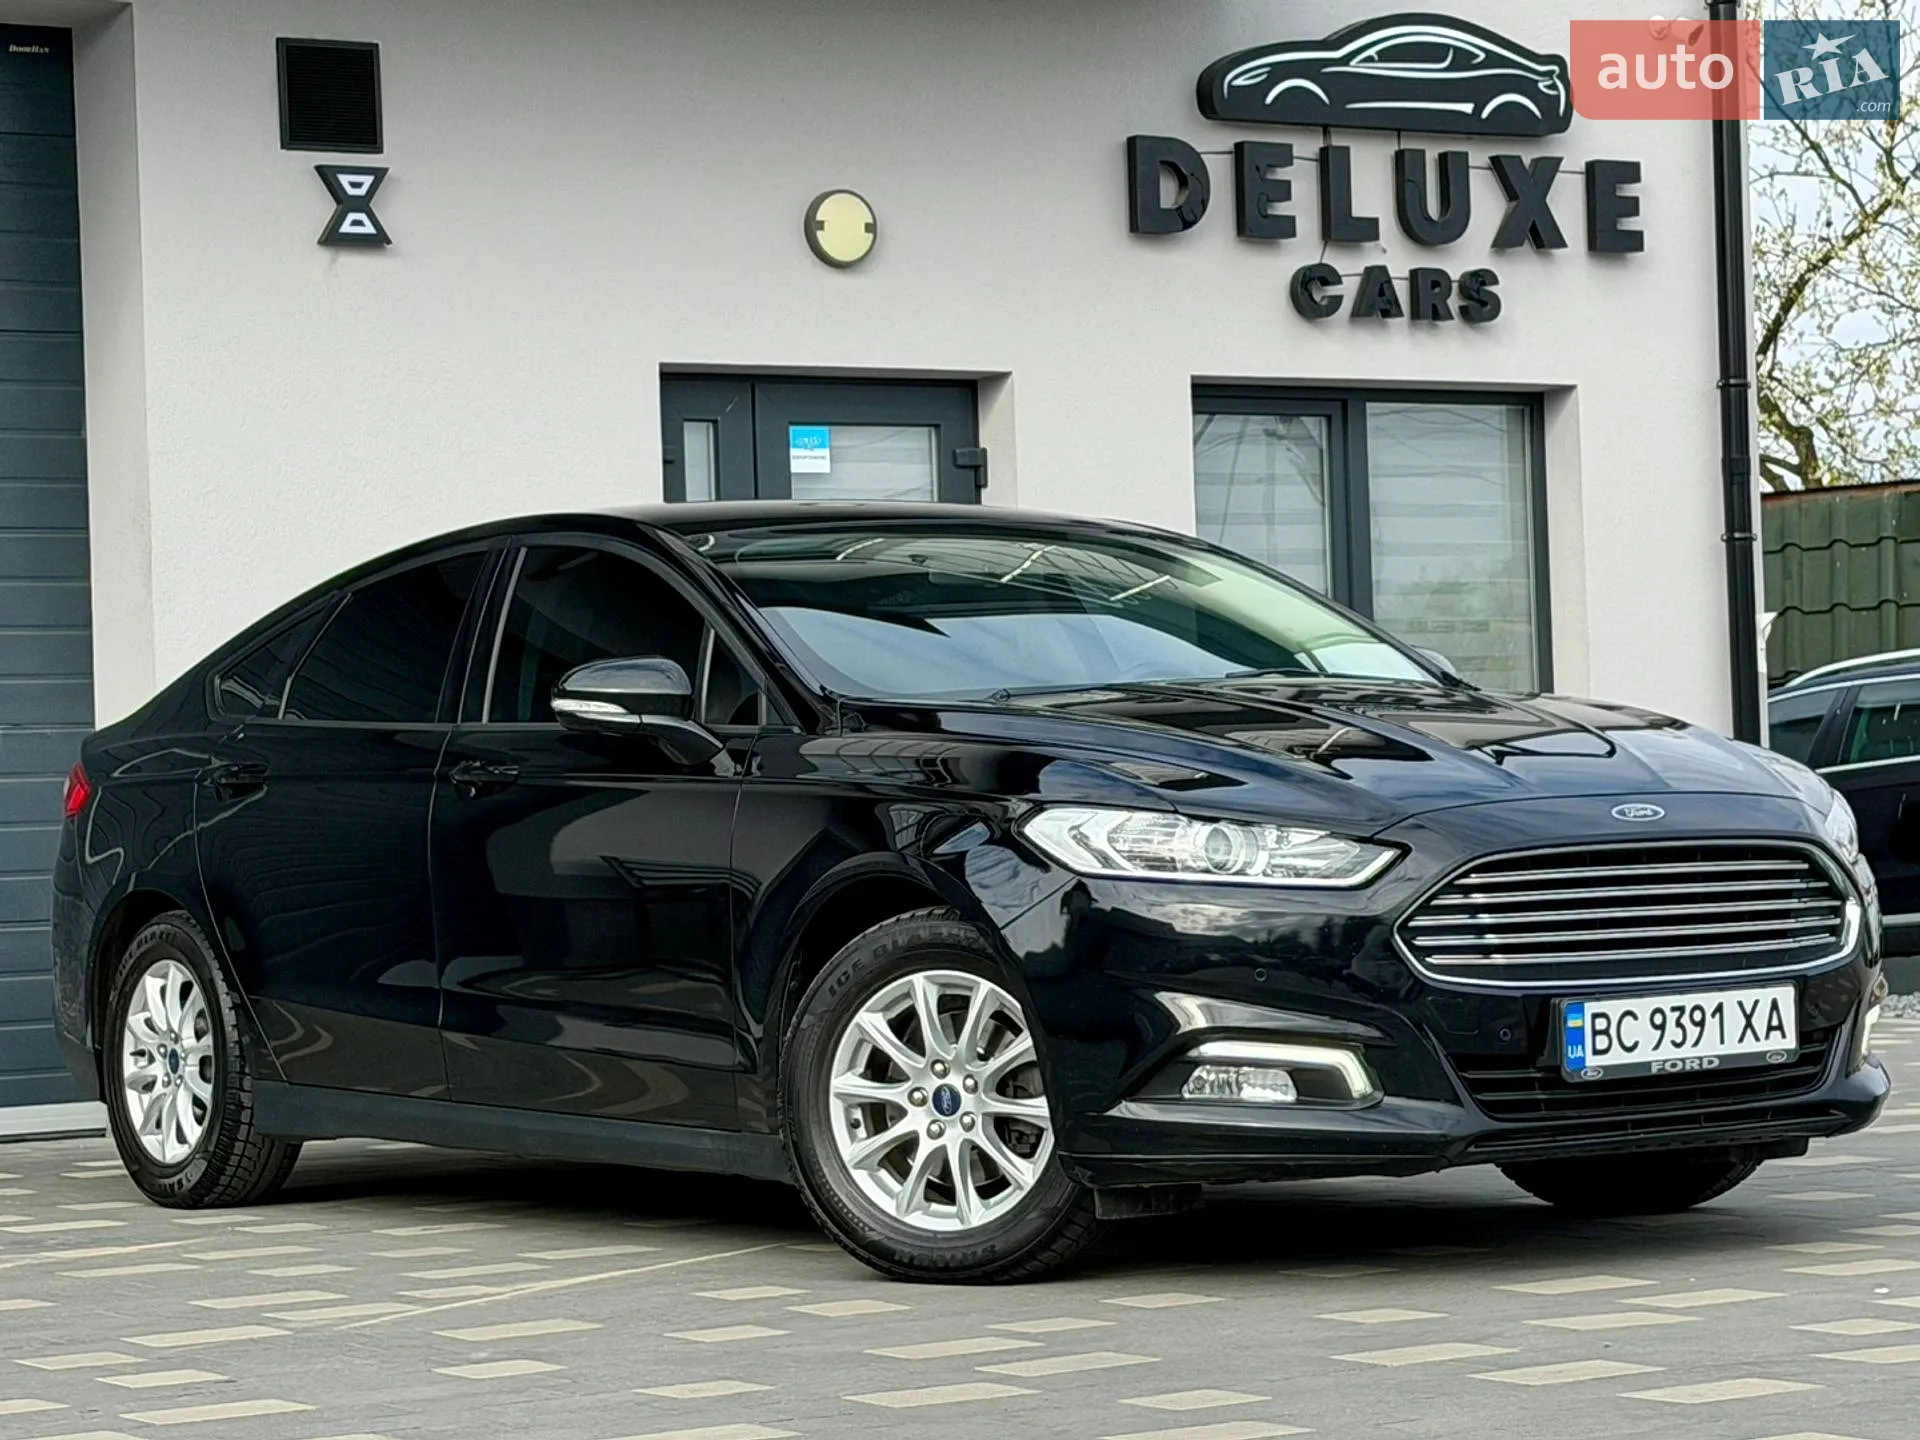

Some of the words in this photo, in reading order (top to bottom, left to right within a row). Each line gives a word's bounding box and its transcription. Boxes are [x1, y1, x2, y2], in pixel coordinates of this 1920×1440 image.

[1127, 135, 1645, 252] DELUXE
[1290, 262, 1502, 323] CARS
[1567, 1045, 1584, 1059] UA
[1590, 1009, 1640, 1057] BC
[1649, 1001, 1726, 1051] 9391
[1736, 997, 1787, 1044] XA
[1650, 1057, 1720, 1074] FORD
